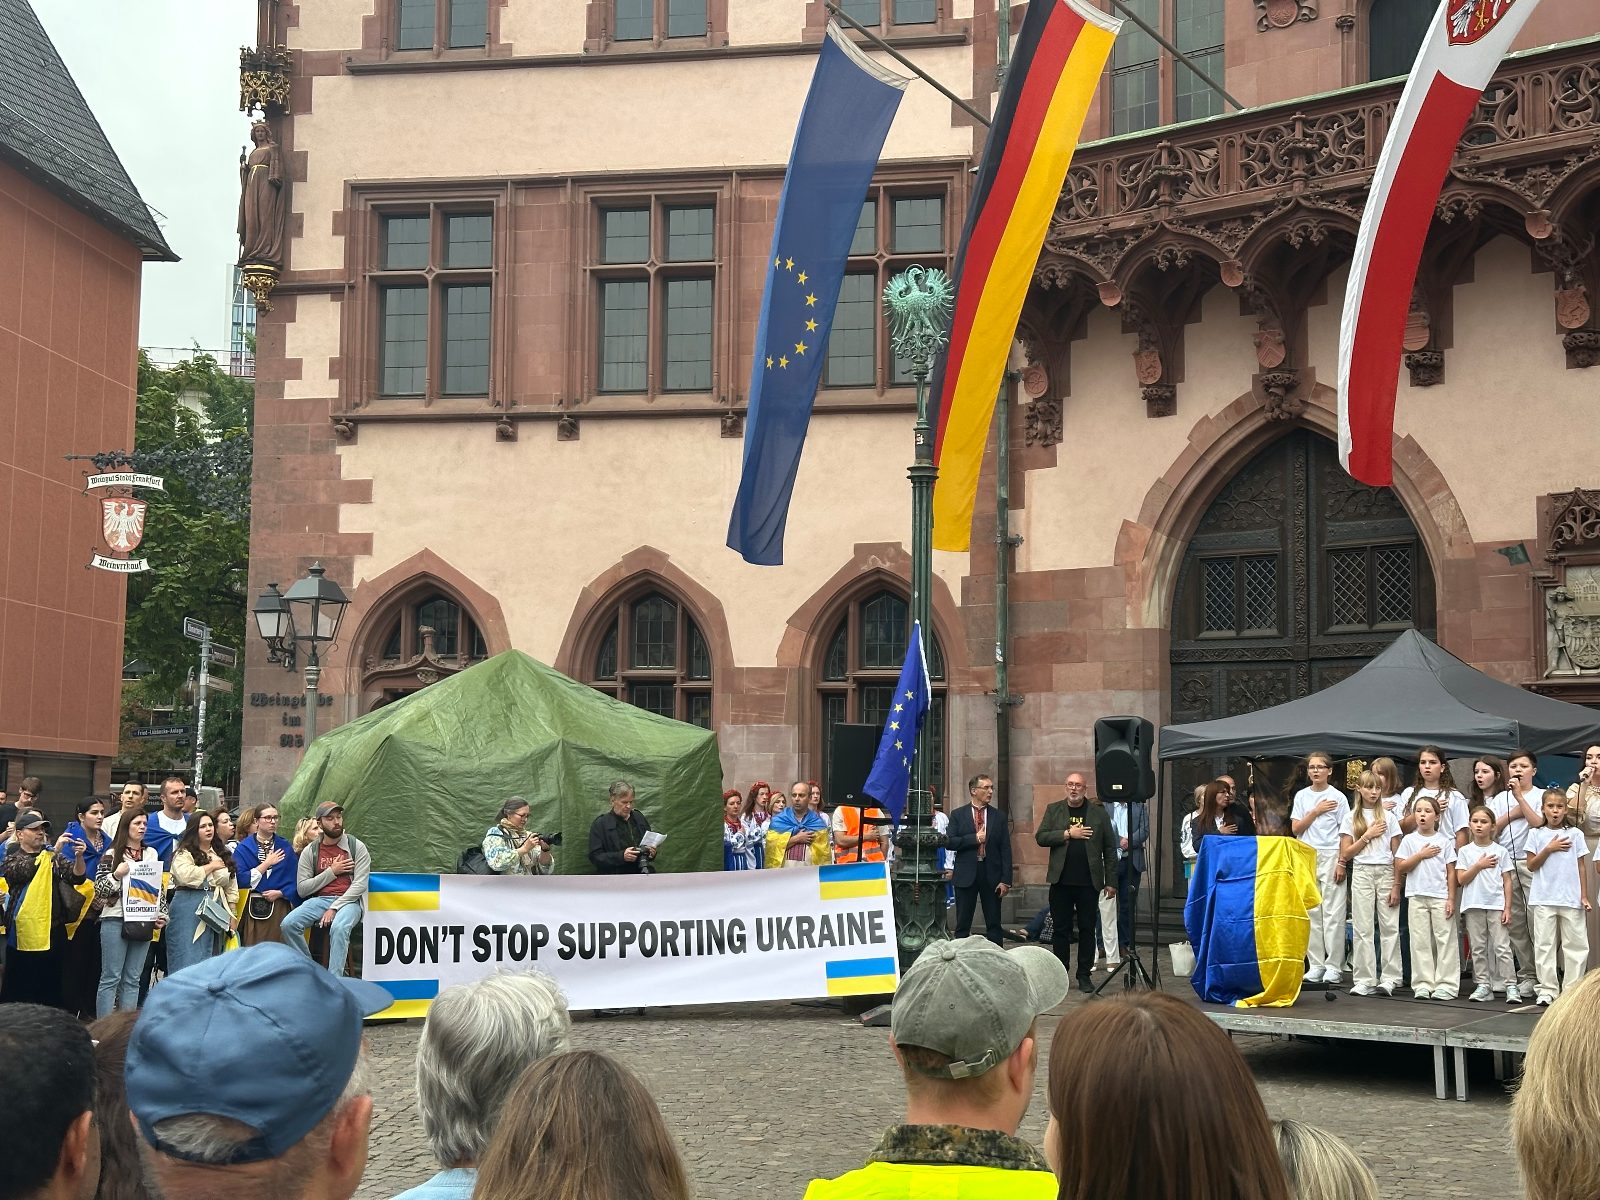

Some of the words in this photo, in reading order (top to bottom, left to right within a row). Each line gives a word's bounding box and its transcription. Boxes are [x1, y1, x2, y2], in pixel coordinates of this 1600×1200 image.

[115, 474, 131, 482] Stadt
[132, 474, 161, 486] Frankfurt
[99, 558, 143, 570] Weinverkauf
[374, 925, 465, 965] DON'T
[471, 924, 550, 963] STOP
[557, 917, 747, 961] SUPPORTING
[755, 909, 887, 952] UKRAINE
